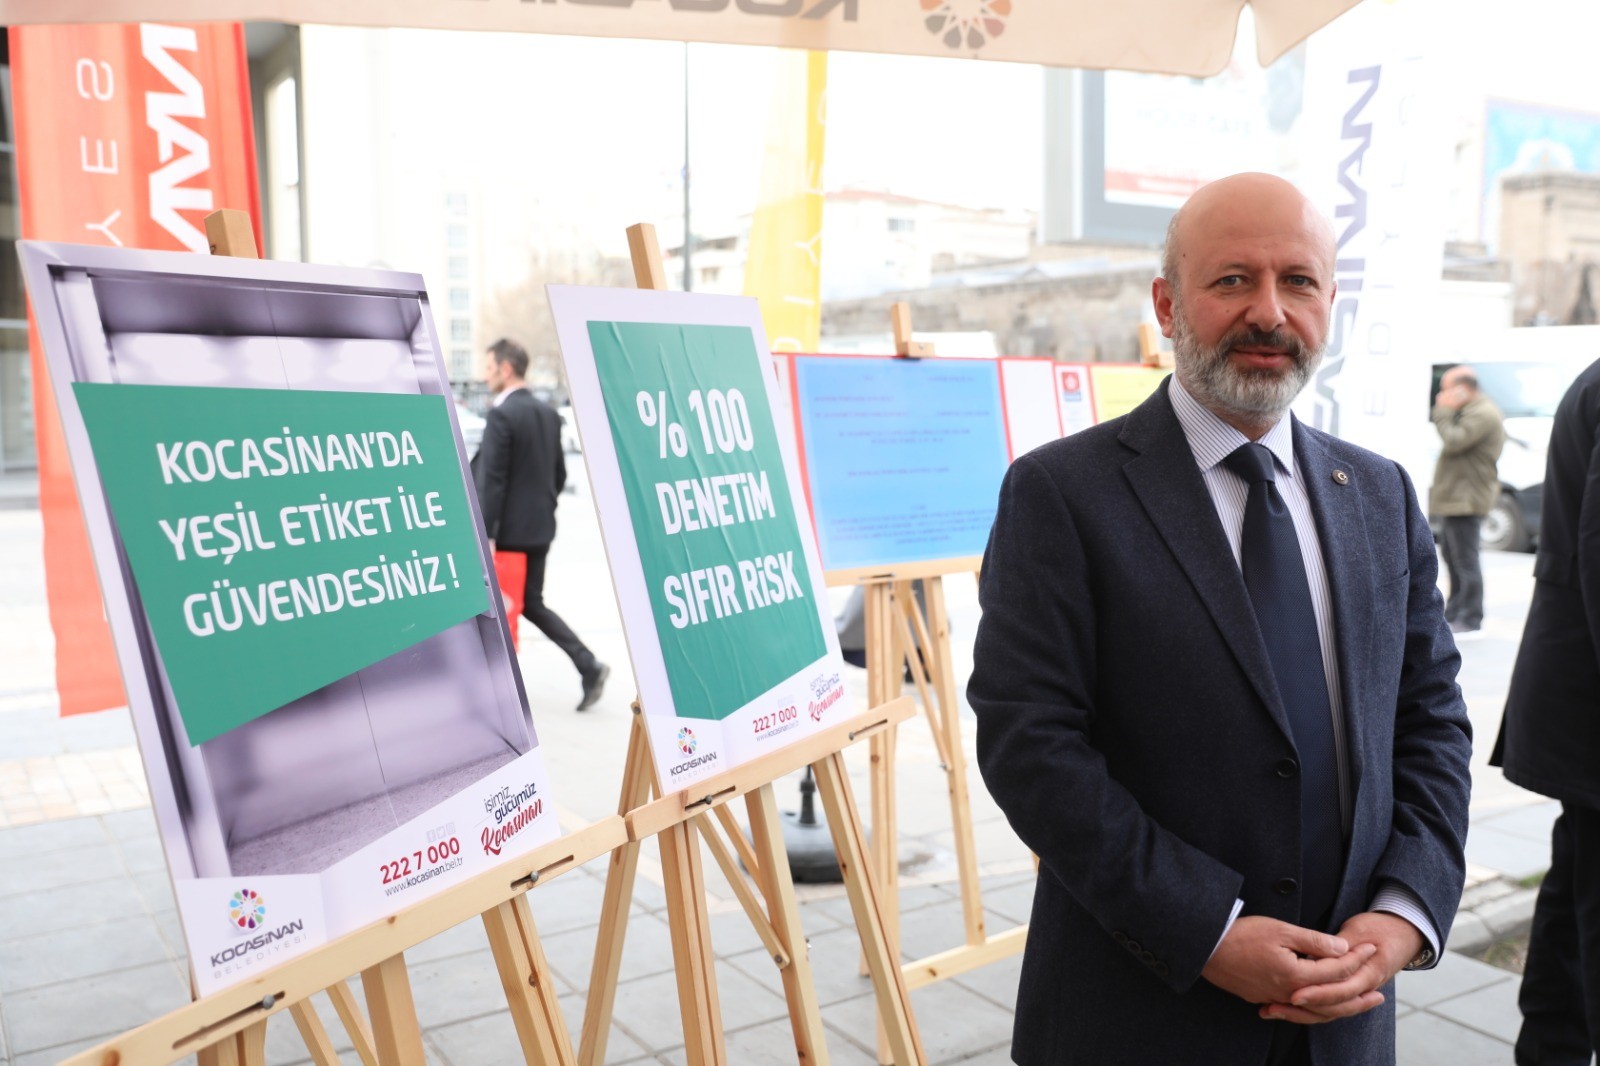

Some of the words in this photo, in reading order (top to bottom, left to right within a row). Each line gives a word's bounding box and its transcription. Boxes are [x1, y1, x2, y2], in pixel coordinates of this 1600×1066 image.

[688, 388, 754, 455] 100
[158, 501, 276, 565] YEŞİL
[279, 493, 393, 546] ETİKET
[397, 486, 447, 531] İLE
[663, 564, 742, 629] SIFIR
[753, 716, 771, 733] 222
[771, 713, 776, 726] 7
[778, 705, 797, 723] 000
[483, 786, 511, 813] işimiz
[494, 782, 537, 824] gücümüz
[481, 798, 543, 856] Kocasinan
[379, 857, 412, 884] 222
[413, 850, 422, 870] 7
[427, 837, 460, 864] 000
[384, 856, 463, 896] www.kocasinan.bel.tr
